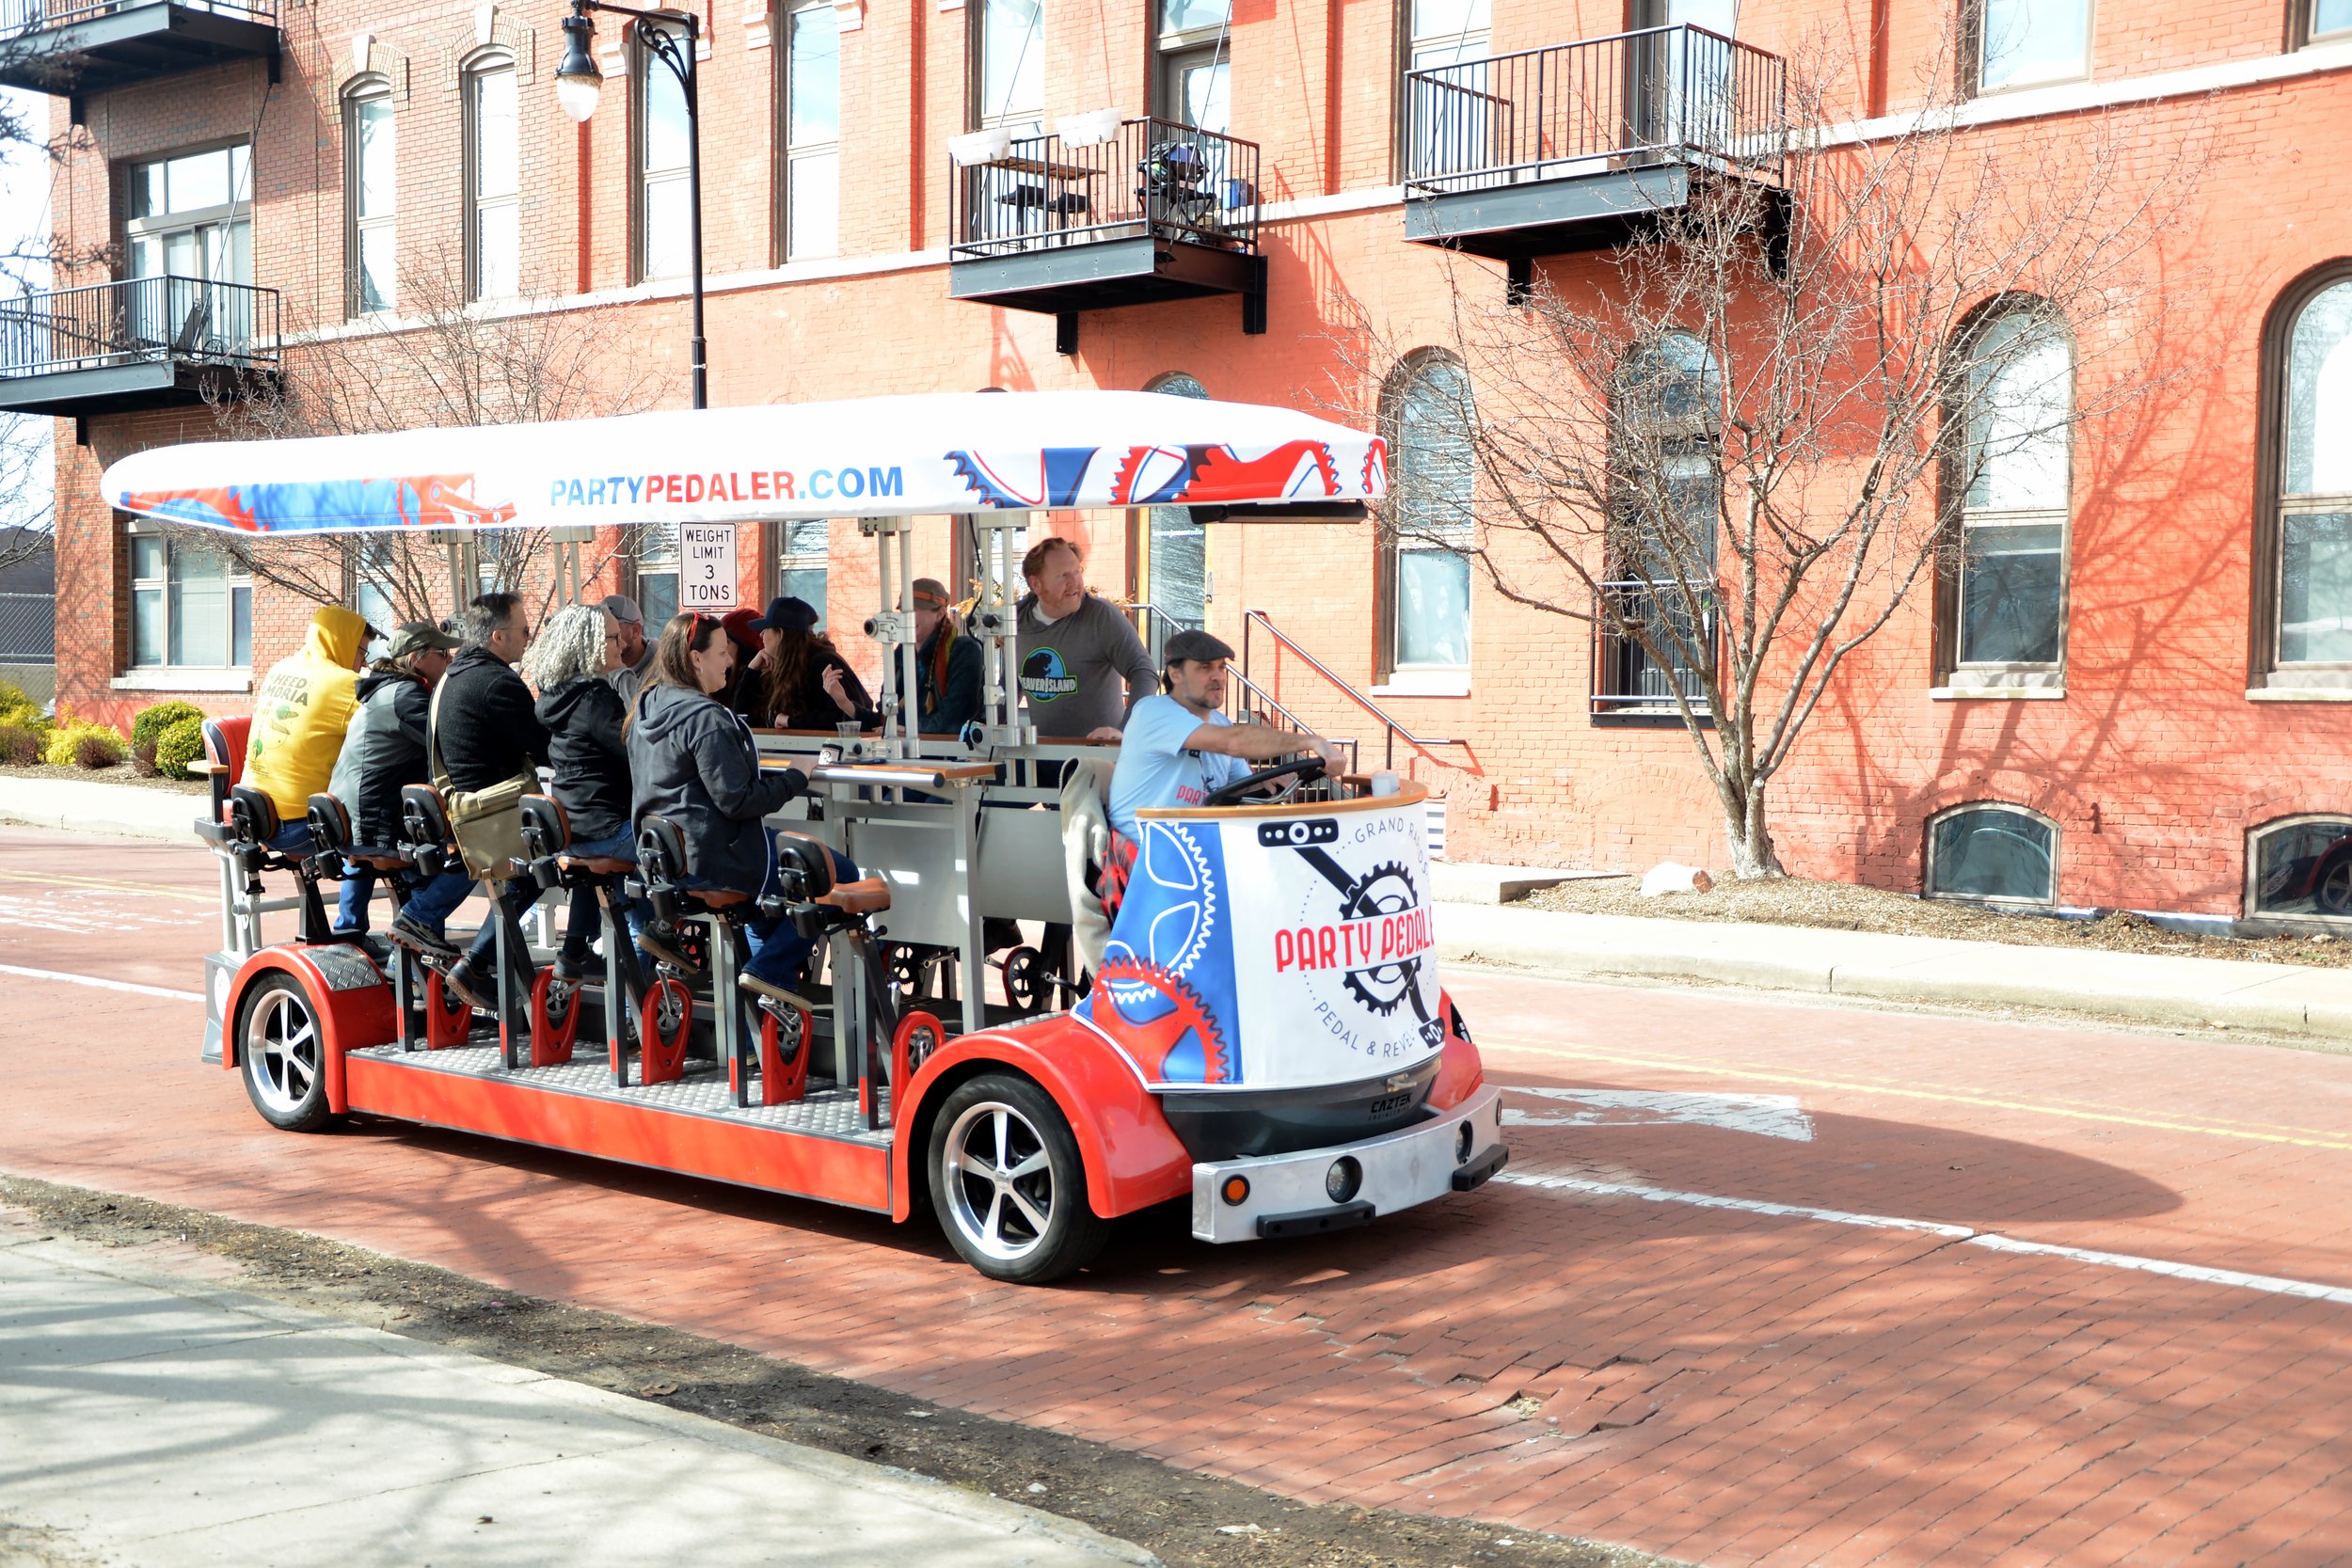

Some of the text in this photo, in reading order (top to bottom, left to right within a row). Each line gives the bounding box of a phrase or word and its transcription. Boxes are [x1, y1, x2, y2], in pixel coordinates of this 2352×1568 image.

[550, 466, 903, 506] PARTYPEDALER.COM
[685, 530, 731, 543] WEIGHT
[692, 546, 724, 559] LIMIT
[705, 564, 715, 579] 3
[690, 584, 730, 600] TONS
[1355, 817, 1404, 843] GRAND
[1275, 919, 1373, 973] PARTY
[1314, 1001, 1359, 1051] PEDAL
[1366, 1040, 1376, 1055] &
[1371, 1092, 1412, 1114] CAZTEK
